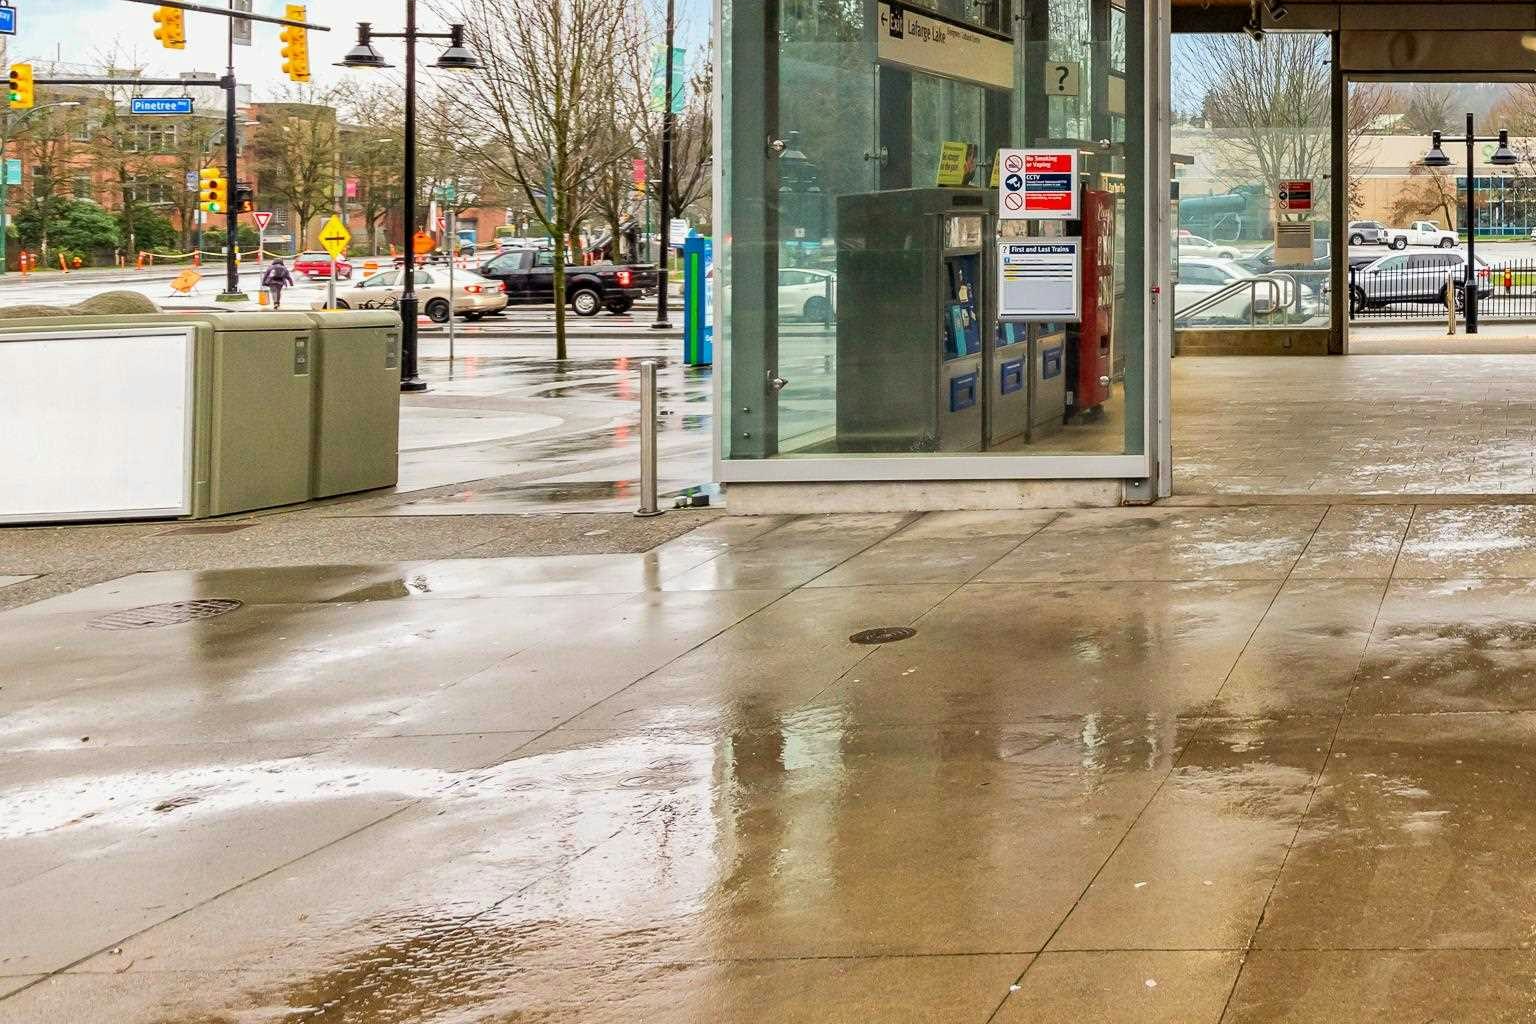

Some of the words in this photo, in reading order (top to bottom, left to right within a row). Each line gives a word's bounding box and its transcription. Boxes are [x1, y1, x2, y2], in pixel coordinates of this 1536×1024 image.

[908, 19, 931, 42] Lafarge
[932, 26, 946, 43] Lake
[135, 101, 177, 111] Pinetree
